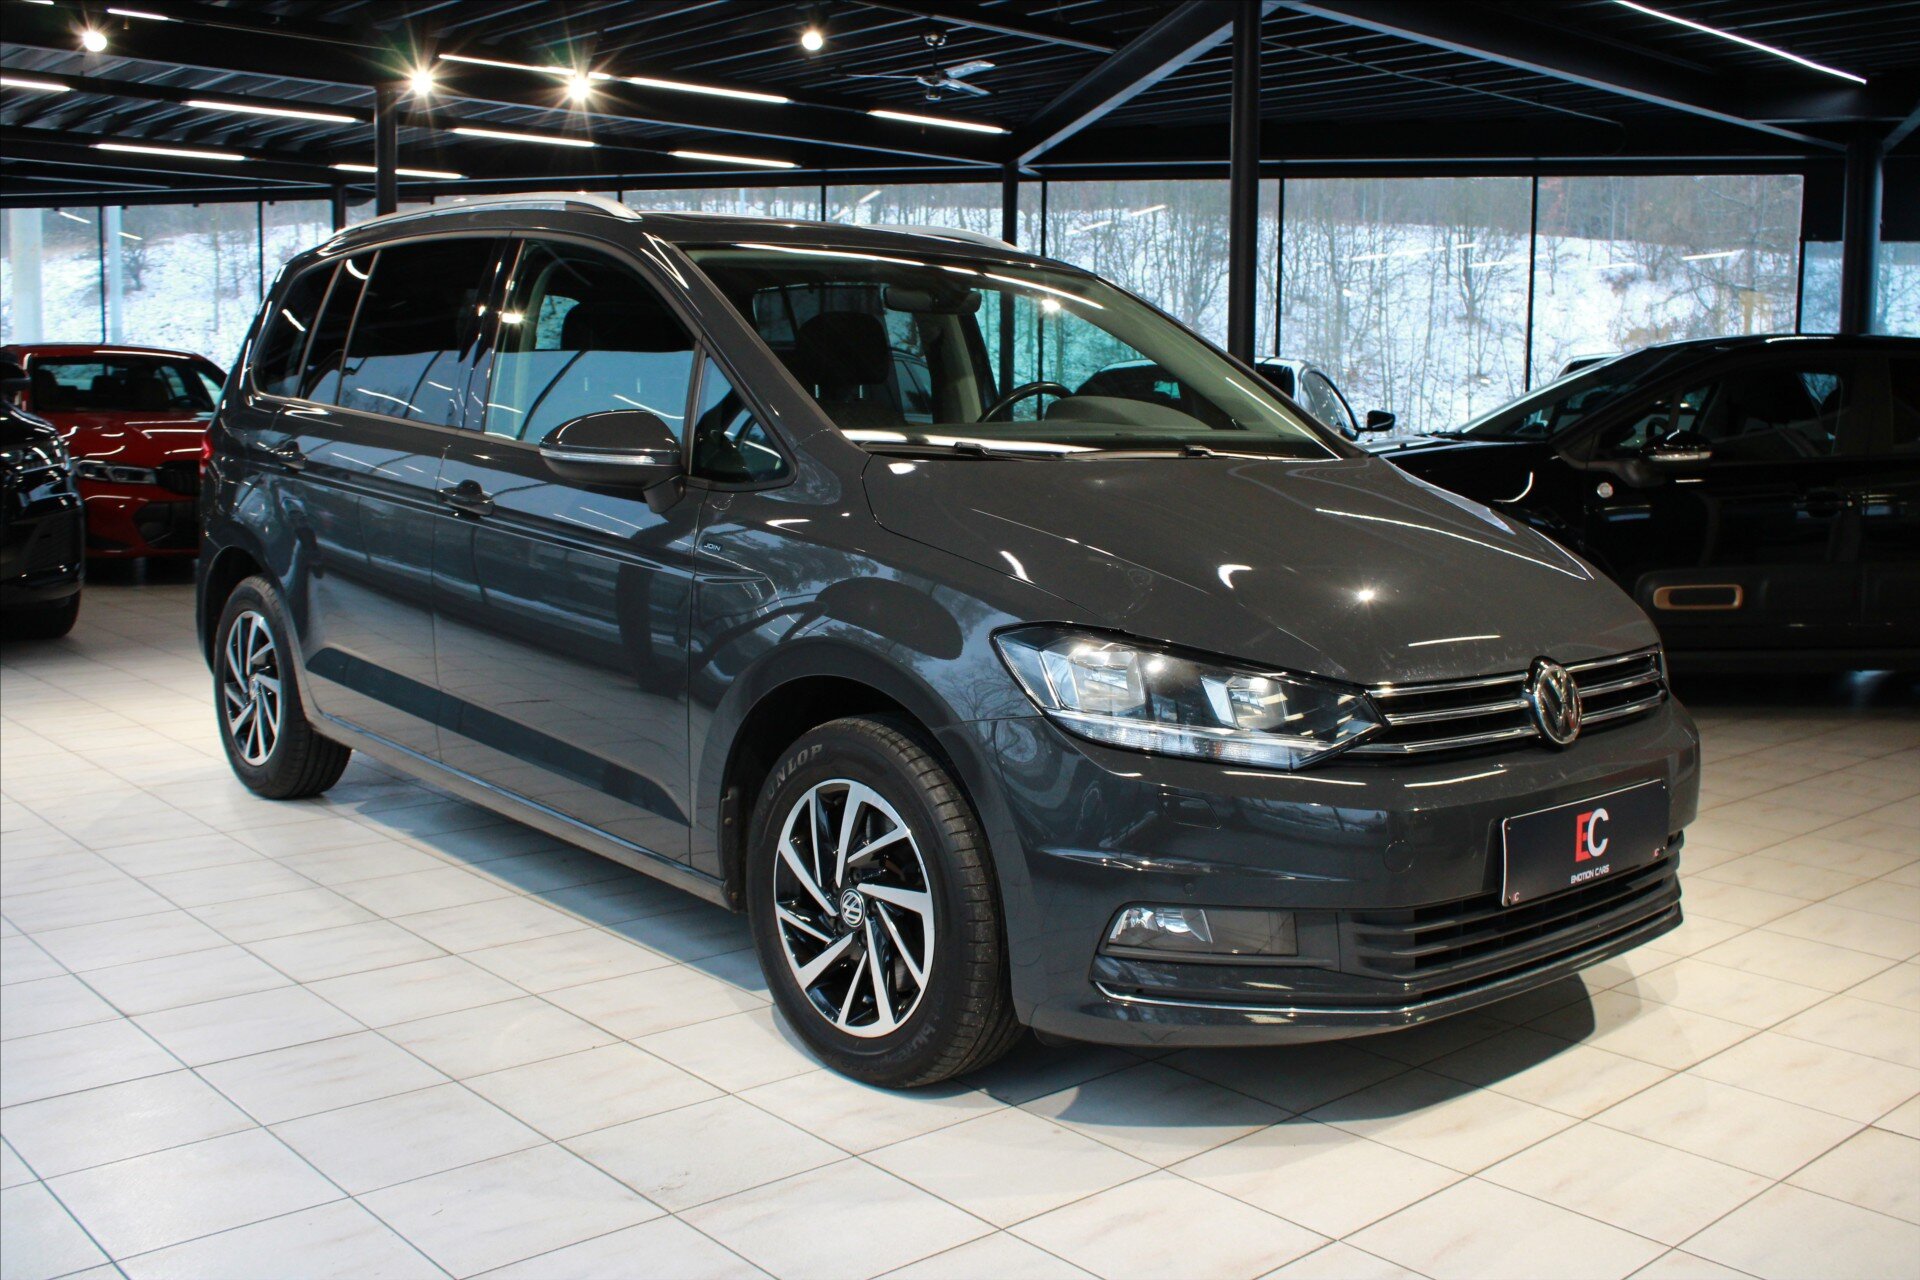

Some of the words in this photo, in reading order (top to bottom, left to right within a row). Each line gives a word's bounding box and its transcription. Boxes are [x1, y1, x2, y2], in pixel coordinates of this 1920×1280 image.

[1575, 808, 1609, 862] EC
[1570, 870, 1594, 884] EMOTION
[1594, 864, 1610, 876] CARS
